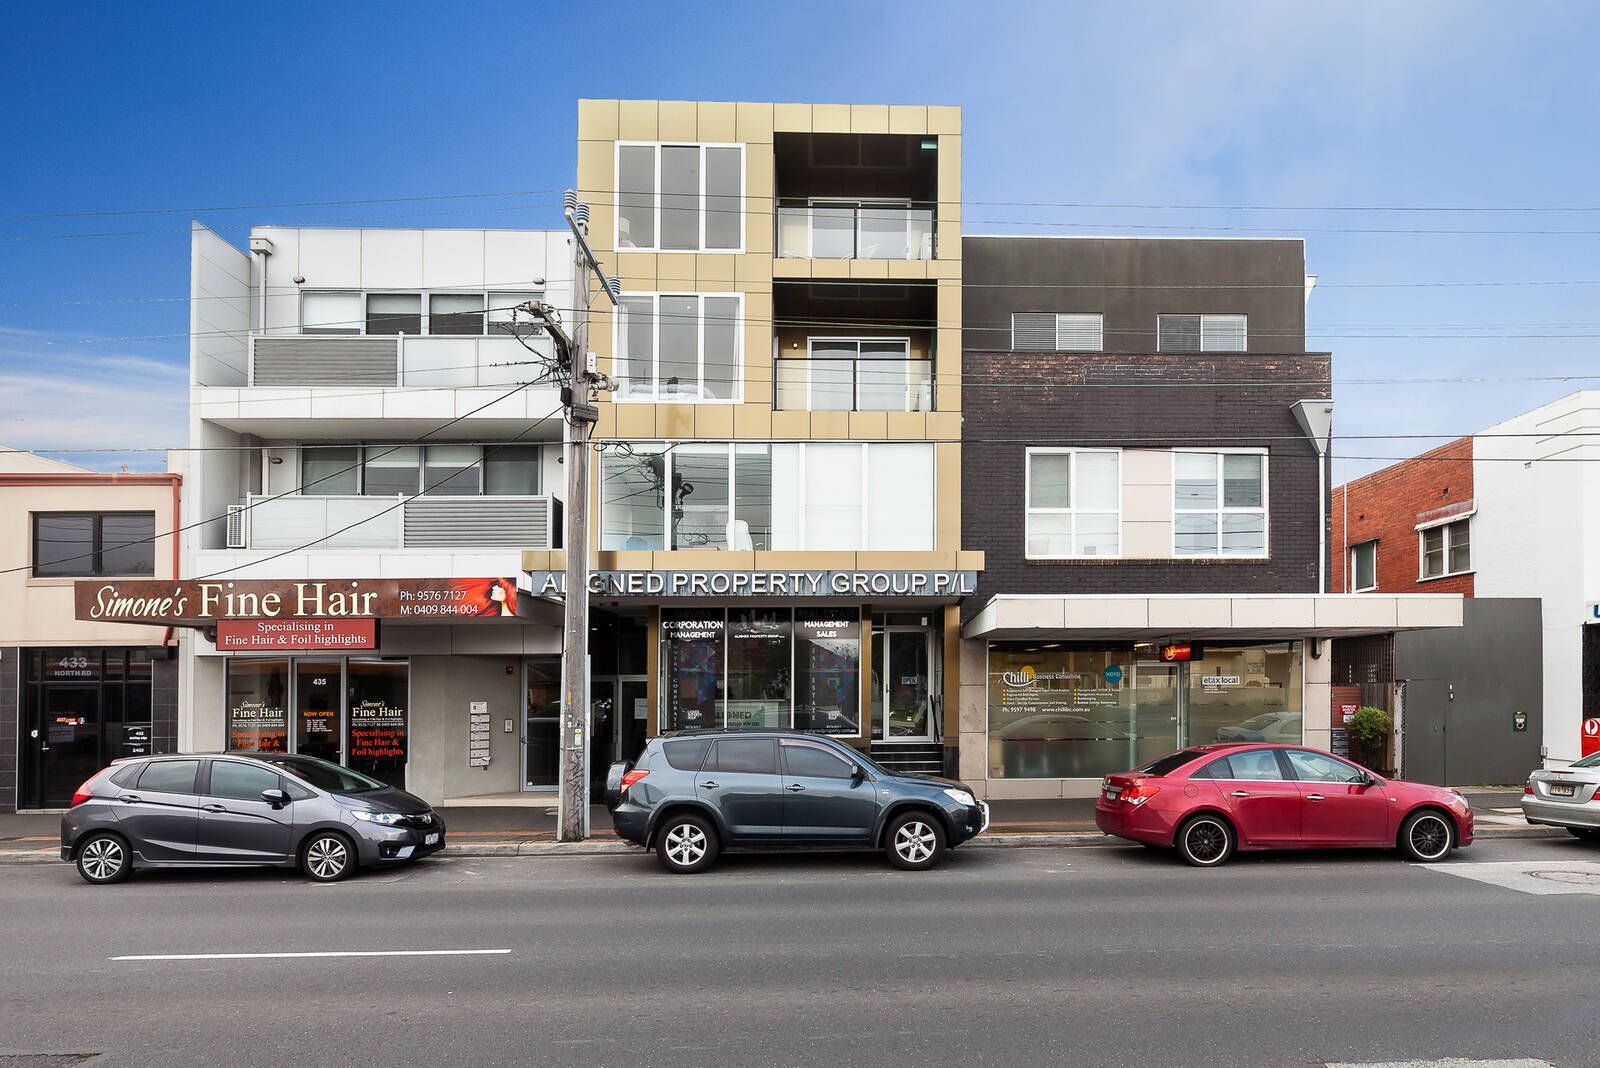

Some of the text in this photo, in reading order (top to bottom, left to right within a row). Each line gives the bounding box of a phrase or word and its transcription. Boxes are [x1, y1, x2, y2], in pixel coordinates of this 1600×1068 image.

[541, 573, 974, 593] ALGNED PROPERTY GROUP P/L
[90, 581, 378, 618] Simone's Fine Hair
[400, 591, 467, 601] Ph: 9576 7127
[400, 605, 479, 614] M: 0409 844 004
[257, 622, 334, 634] Specialising in
[662, 621, 724, 629] CORPORATION
[670, 631, 716, 639] MANAGEMENT
[816, 630, 838, 638] SALES
[225, 635, 367, 645] Fine Hair & Foil highlights
[59, 656, 88, 668] 433
[312, 678, 327, 686] 435
[1003, 671, 1032, 687] Chilli
[232, 707, 284, 718] Fine Hair
[352, 706, 403, 717] Fine Hair
[352, 730, 396, 738] Specialising
[272, 739, 280, 747] &
[374, 738, 390, 746] Hair
[391, 738, 400, 746] &
[352, 748, 404, 758] Foil highlights
